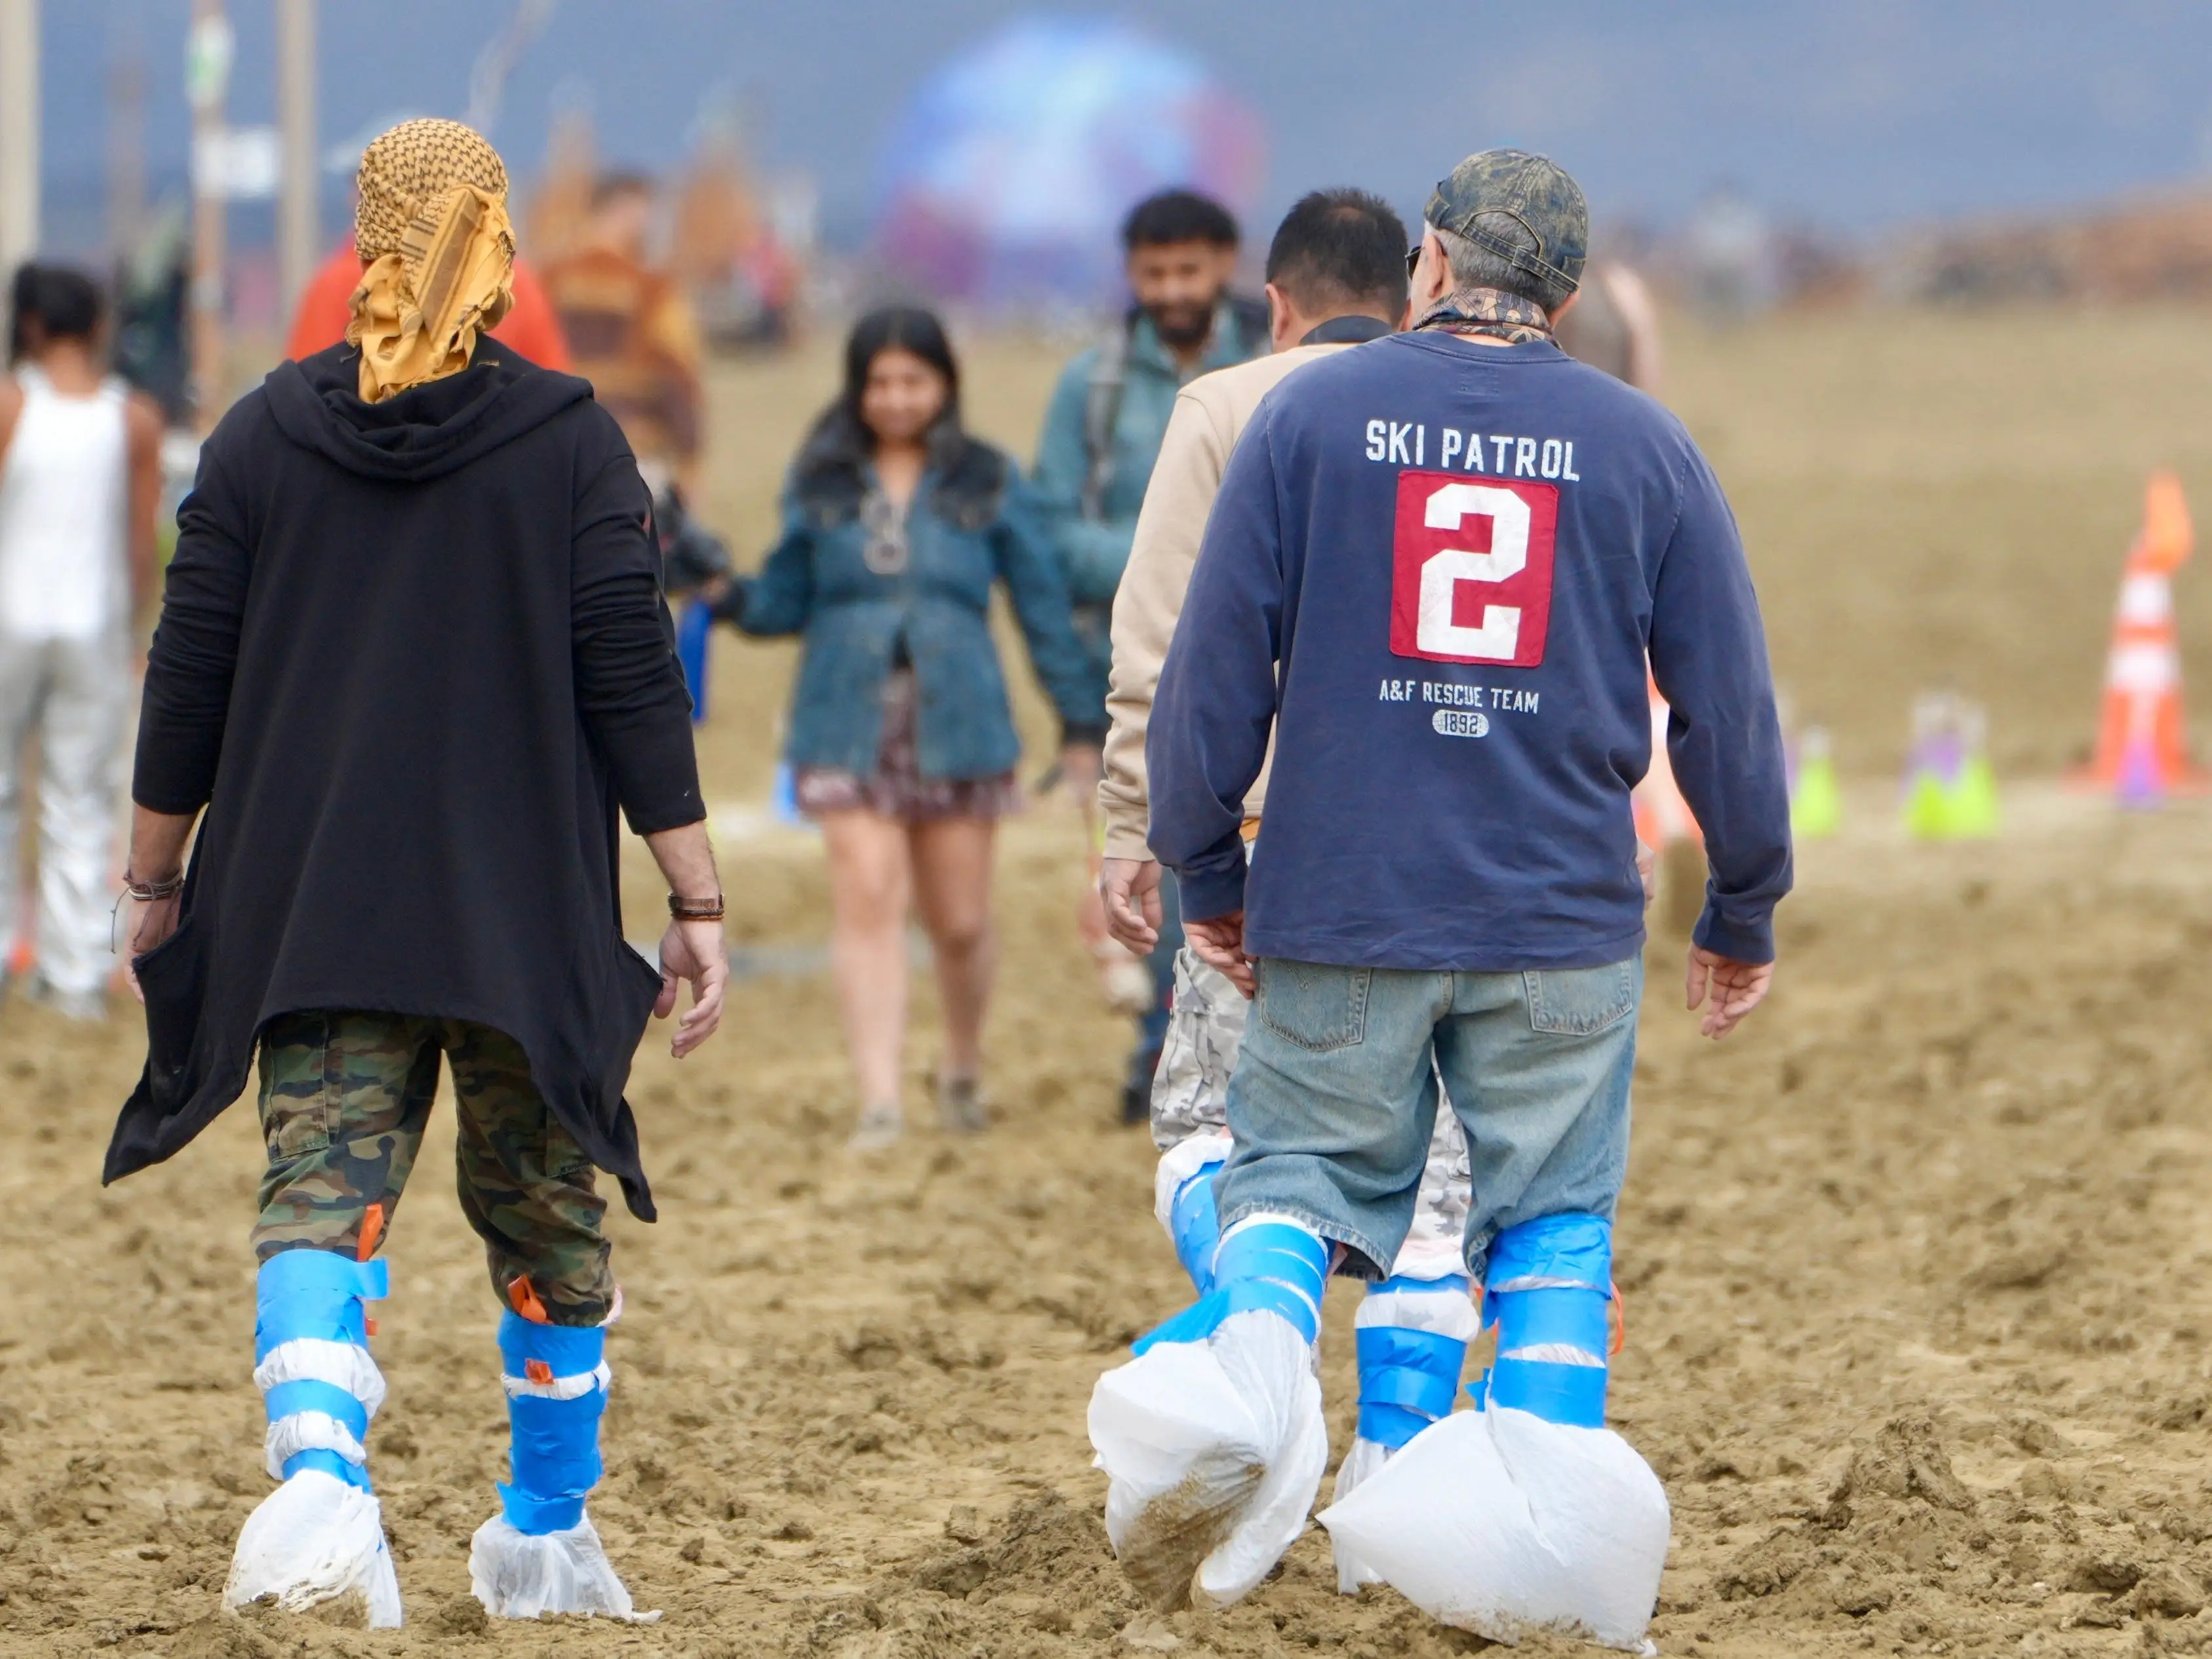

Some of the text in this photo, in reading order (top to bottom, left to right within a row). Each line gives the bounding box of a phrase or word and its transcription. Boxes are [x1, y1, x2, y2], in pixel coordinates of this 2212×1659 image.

[1366, 420, 1580, 482] SKI PATROL
[1417, 483, 1531, 660] 2
[1379, 679, 1539, 714] A&F RESCUE TEAM
[1443, 712, 1478, 734] 1892
